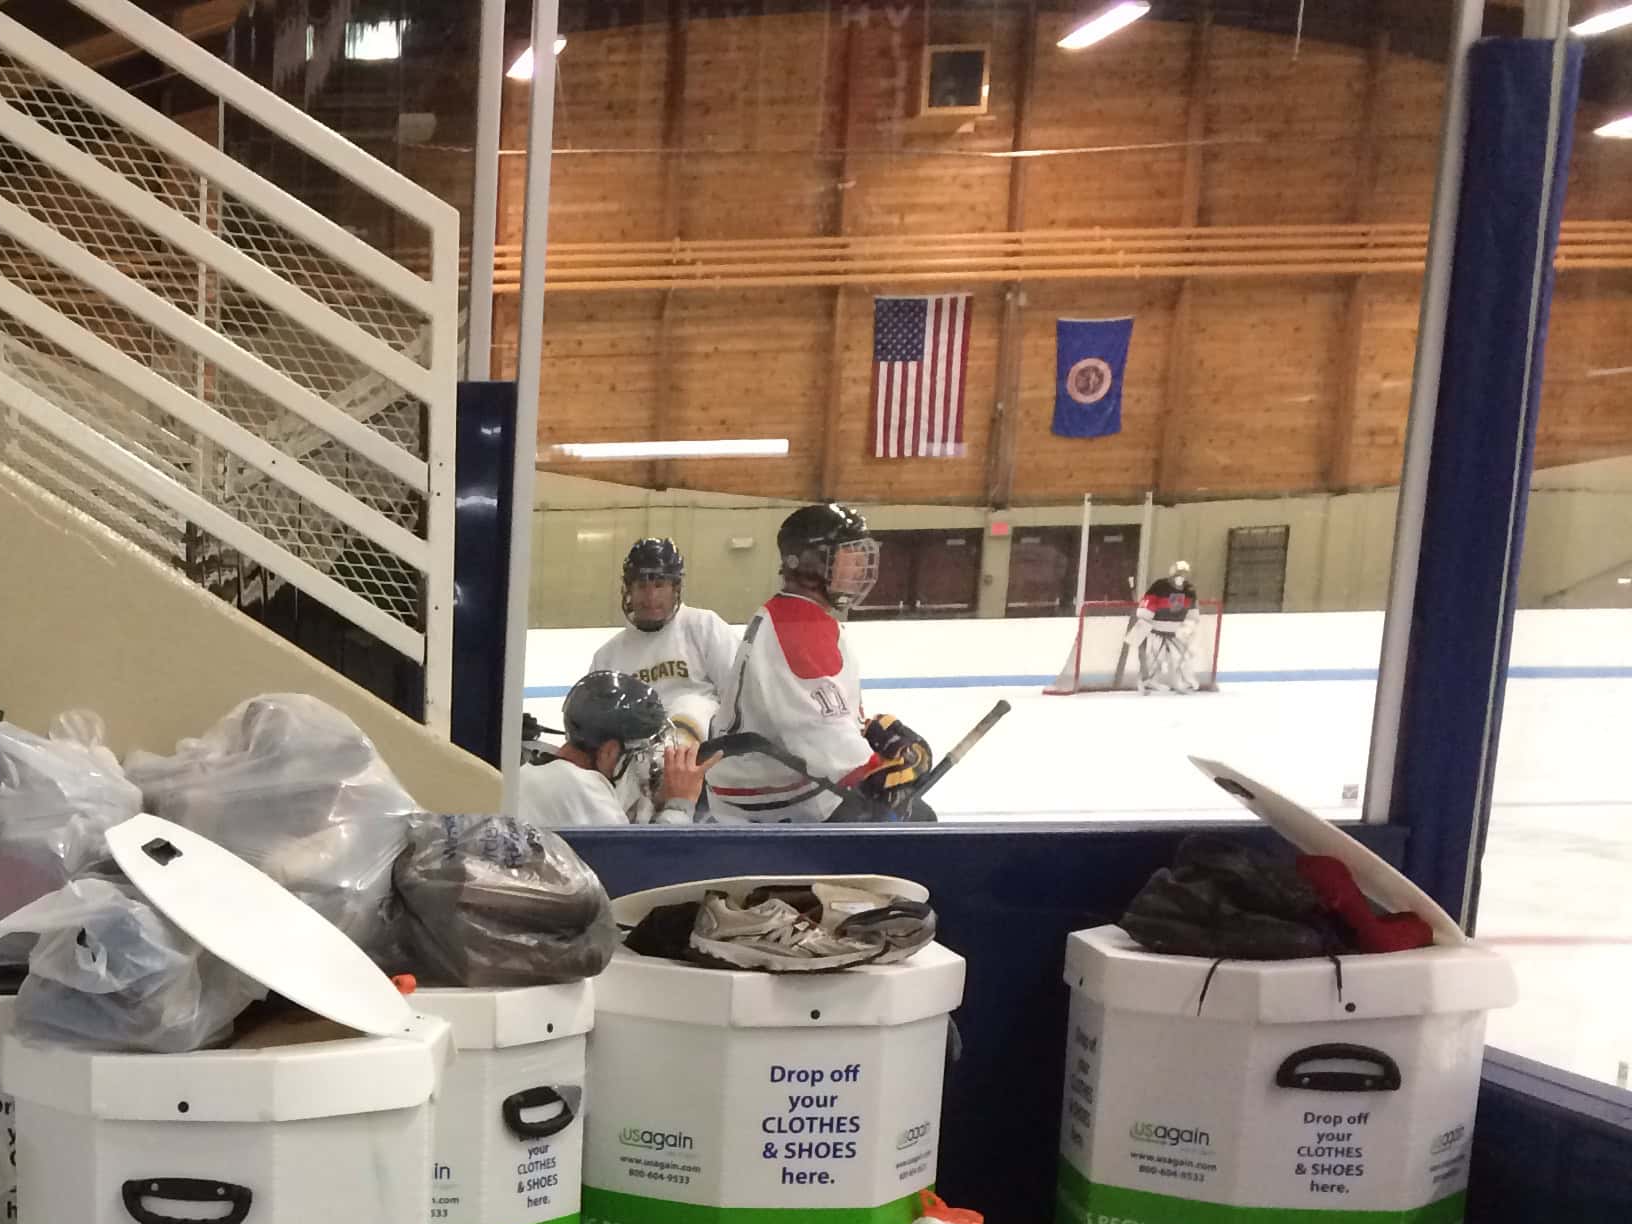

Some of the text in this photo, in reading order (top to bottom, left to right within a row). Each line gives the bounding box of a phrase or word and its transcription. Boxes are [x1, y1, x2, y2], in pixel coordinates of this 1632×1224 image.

[632, 660, 689, 683] BCATS
[769, 1063, 861, 1087] Drop off
[788, 1094, 838, 1113] your
[762, 1116, 861, 1134] CLOTHES
[1304, 1110, 1370, 1129] Drop off
[620, 1127, 694, 1151] usagain
[1132, 1121, 1210, 1146] usagain
[1317, 1130, 1352, 1144] your
[527, 1144, 550, 1159] your
[762, 1141, 857, 1159] & SHOES
[1297, 1146, 1362, 1159] CLOTHES
[517, 1157, 556, 1175] CLOTHES
[1295, 1163, 1364, 1176] & SHOES
[517, 1174, 558, 1194] & SHOES
[781, 1167, 835, 1185] here.
[1310, 1180, 1350, 1194] here.
[527, 1194, 551, 1208] here.
